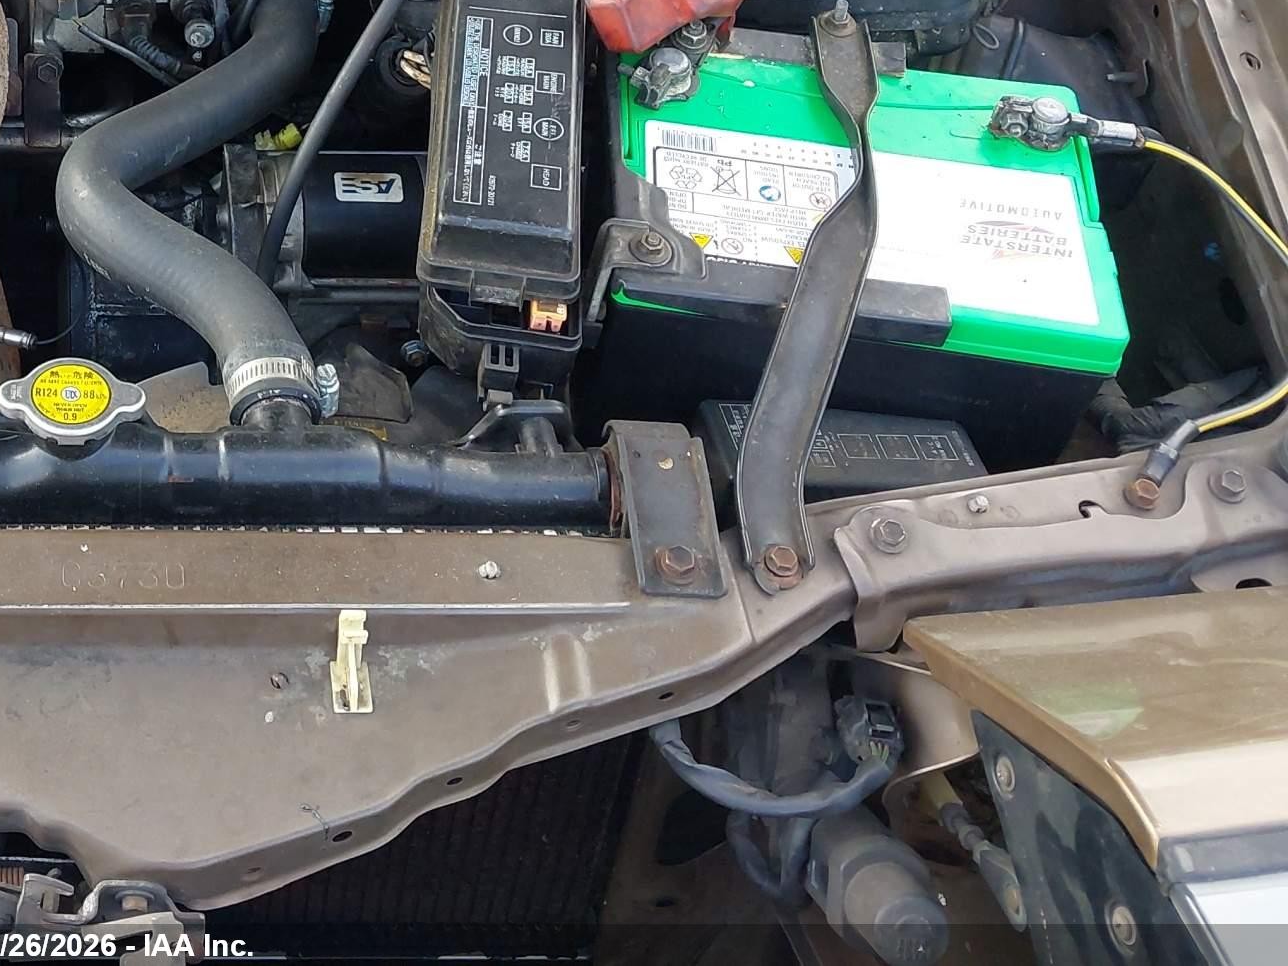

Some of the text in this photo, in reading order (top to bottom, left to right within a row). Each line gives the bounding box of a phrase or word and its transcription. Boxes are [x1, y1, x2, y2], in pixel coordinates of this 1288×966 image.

[479, 48, 490, 77] NOTICE
[542, 169, 550, 186] HEAD
[959, 199, 1062, 220] AUTOMOTIVE
[967, 224, 1067, 246] BATTERIES
[960, 235, 1073, 258] INTERSTATE
[35, 388, 58, 397] R124
[63, 413, 78, 421] 0.9
